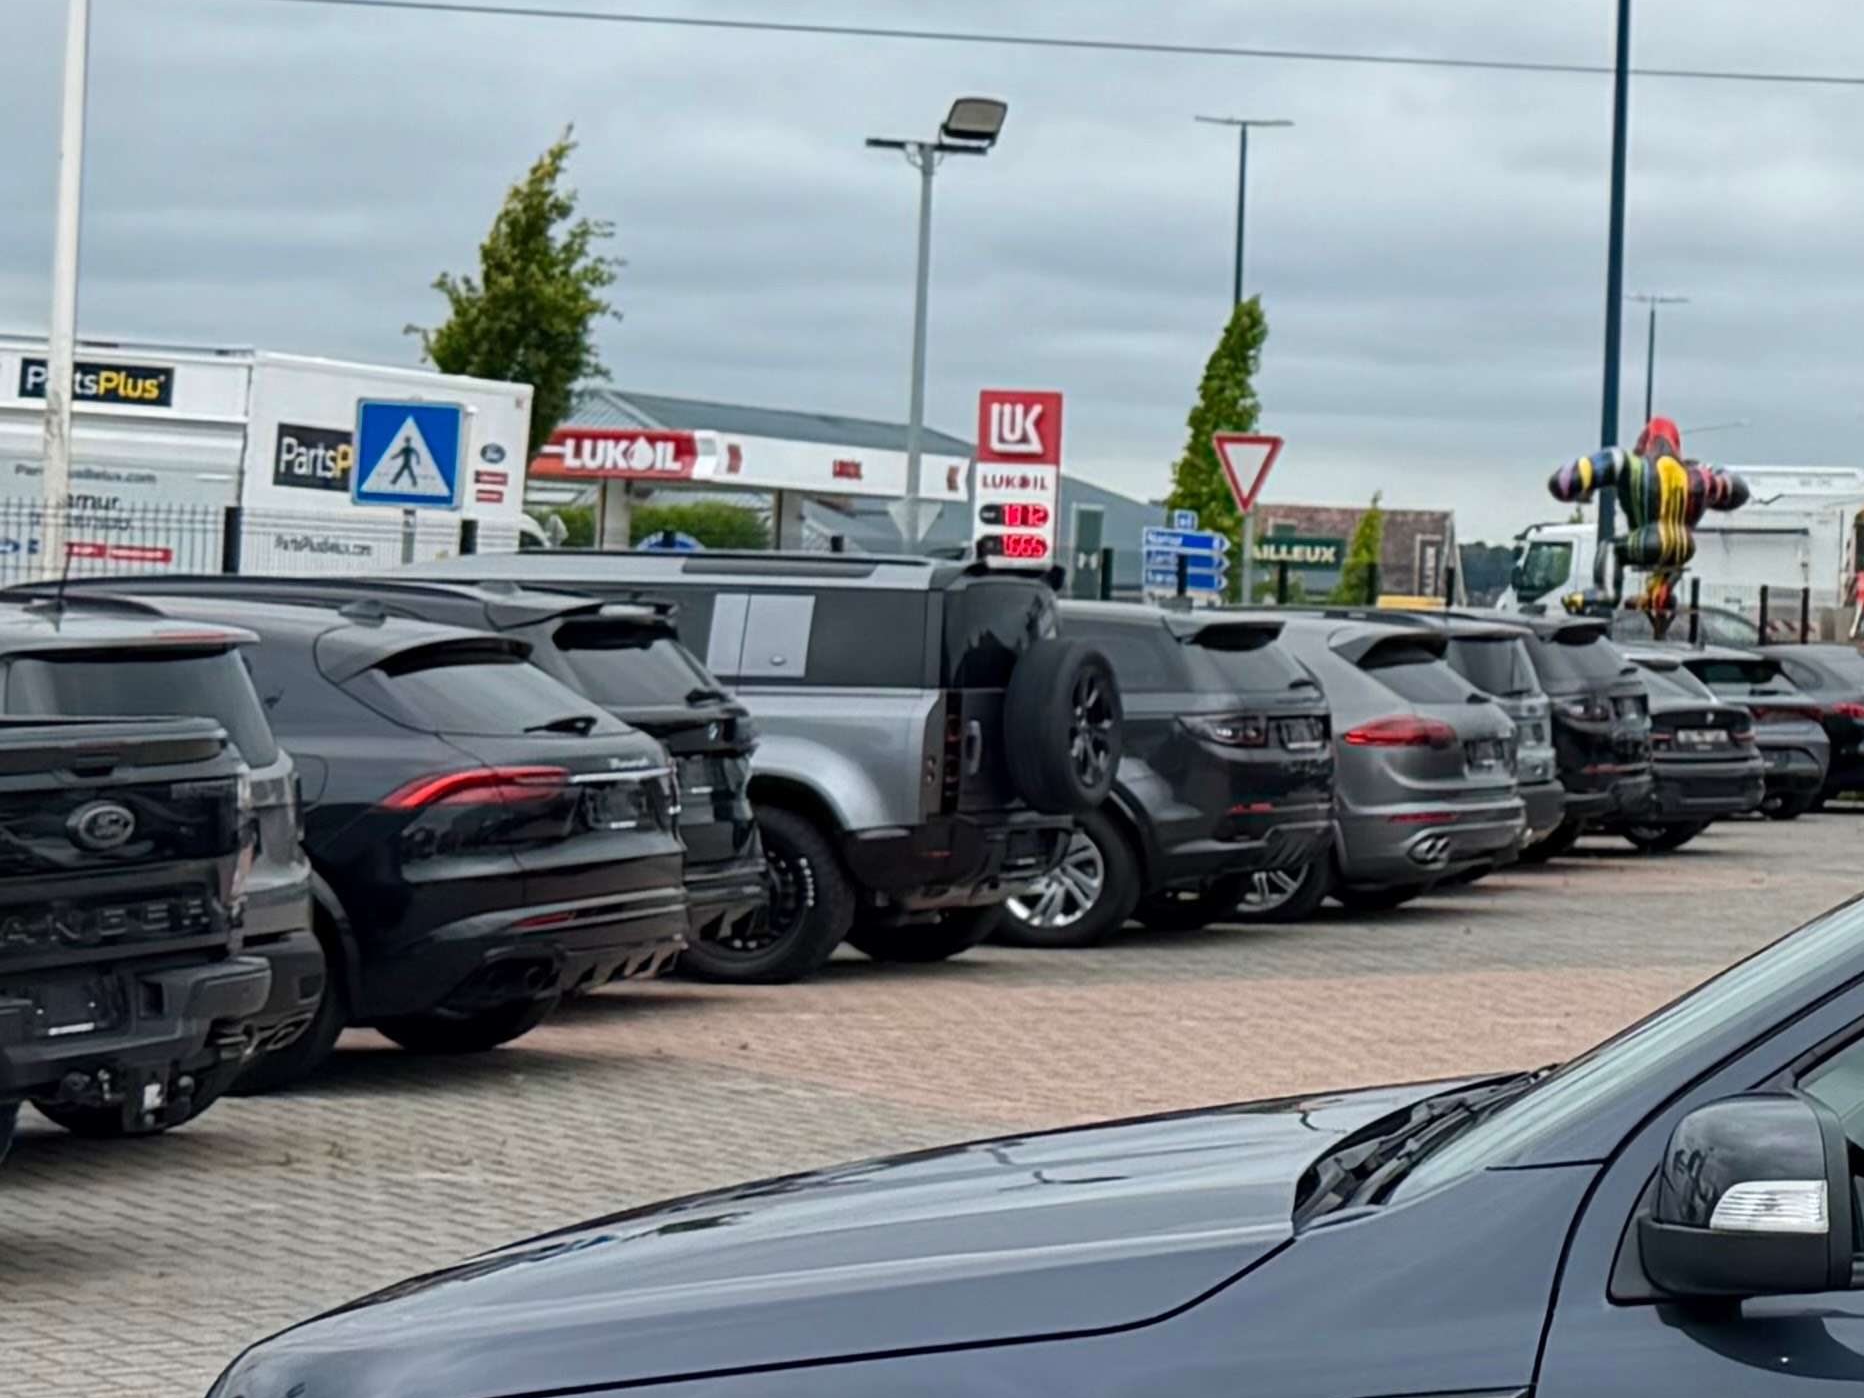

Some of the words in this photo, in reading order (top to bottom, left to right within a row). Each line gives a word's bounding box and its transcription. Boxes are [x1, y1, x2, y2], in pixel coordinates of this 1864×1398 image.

[26, 365, 160, 399] PtsPlus
[279, 437, 354, 479] PartsP
[564, 437, 682, 471] LUKOIL
[982, 474, 1048, 491] LUKOIL
